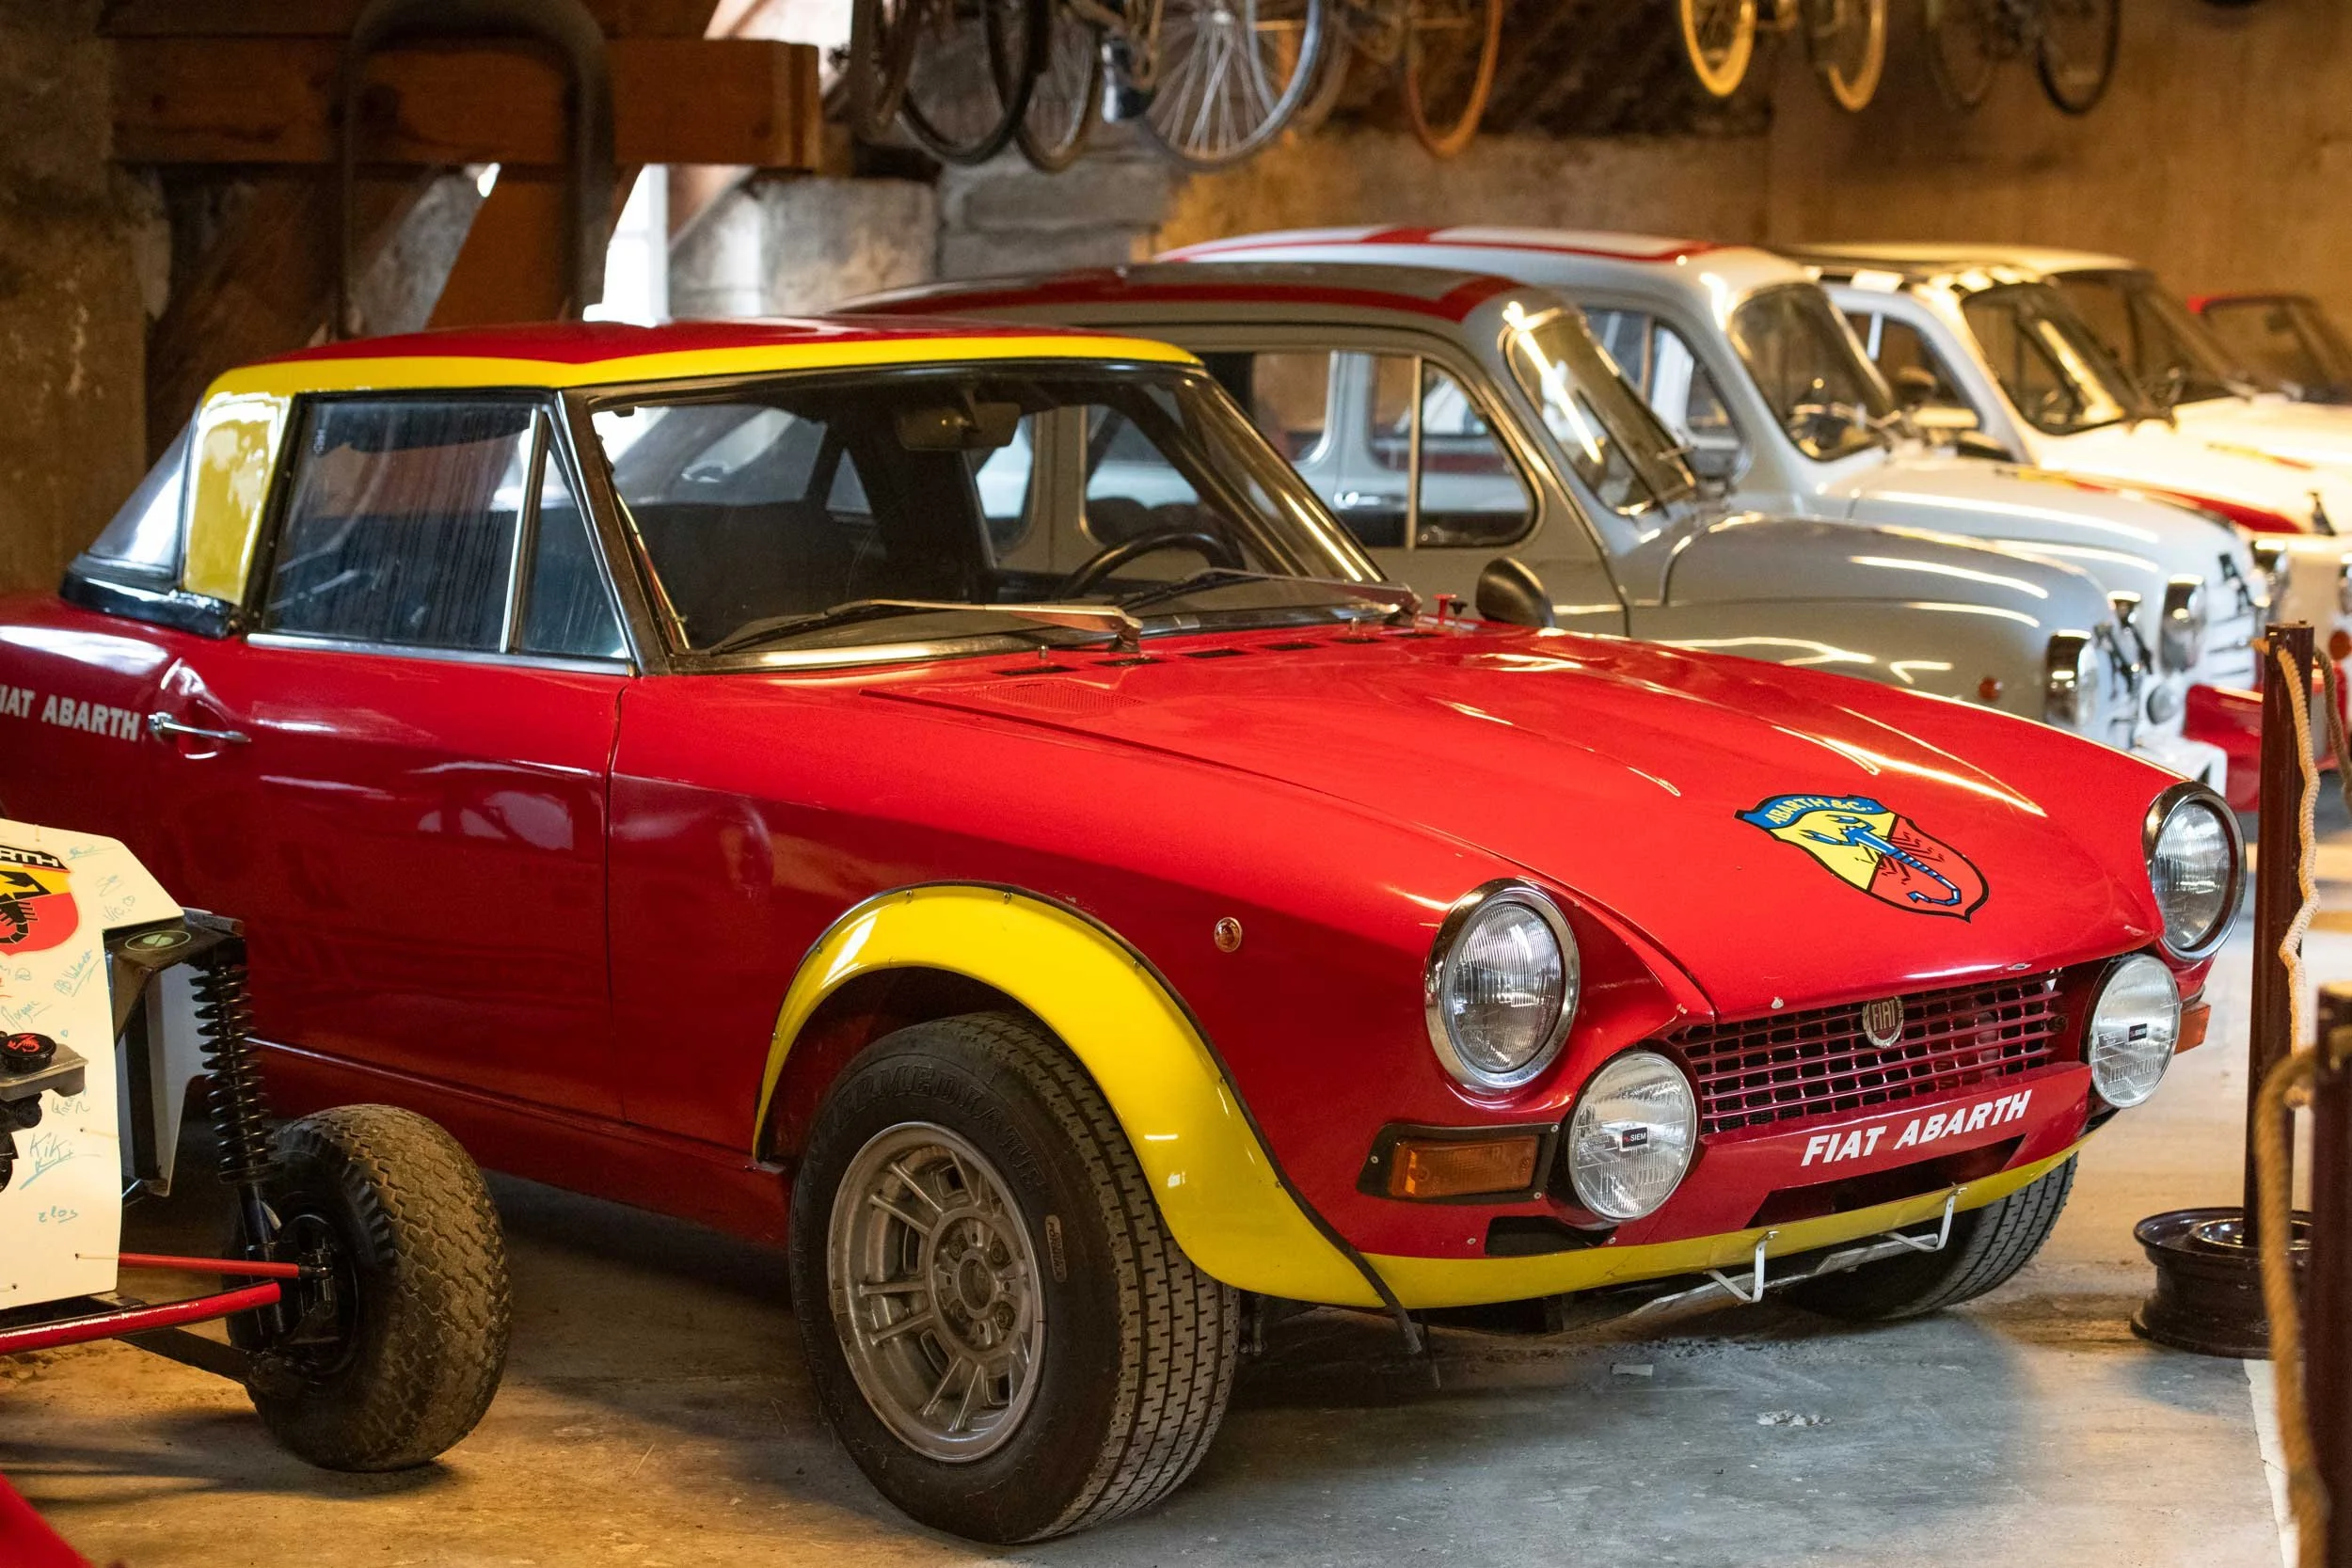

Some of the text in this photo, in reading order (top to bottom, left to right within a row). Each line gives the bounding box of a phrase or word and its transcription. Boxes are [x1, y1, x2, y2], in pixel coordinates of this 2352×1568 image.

[41, 694, 140, 741] ABARTH
[1765, 798, 1831, 825] ABARTH
[1871, 999, 1896, 1032] FIAT
[1630, 1132, 1646, 1142] SIEM
[1801, 1089, 2032, 1166] FIAT ABARTH
